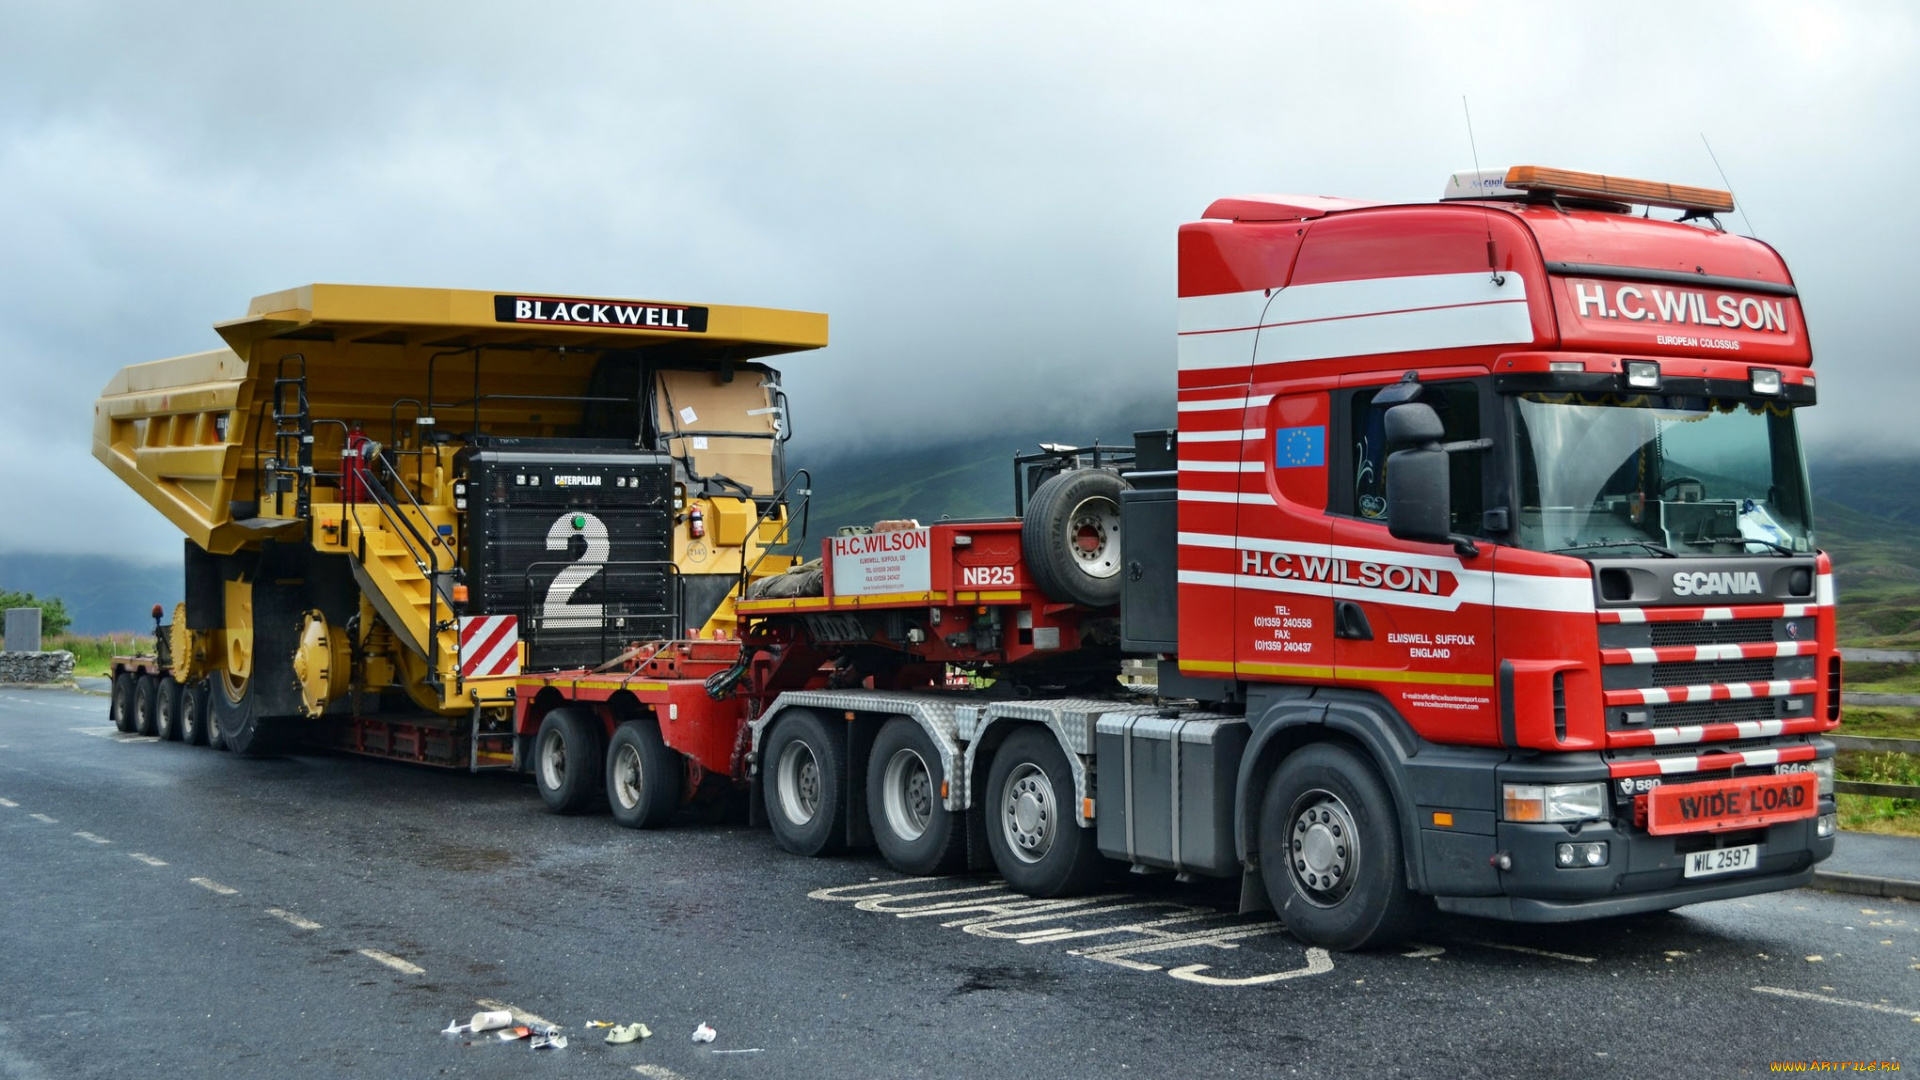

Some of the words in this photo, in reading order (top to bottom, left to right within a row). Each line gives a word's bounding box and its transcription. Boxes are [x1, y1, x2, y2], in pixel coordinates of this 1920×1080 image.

[515, 299, 690, 328] BLACKWELL
[1575, 283, 1786, 332] H.C.WILSON
[1656, 335, 1698, 347] EUROPEAN
[1699, 337, 1740, 350] COLOSSUS
[554, 474, 602, 487] CATERPILLAR
[835, 530, 927, 556] H.C.WILSON
[541, 511, 610, 629] 2
[963, 566, 1015, 586] NB25
[1241, 550, 1439, 595] H.C.WILSON
[1672, 571, 1762, 596] SCANIA
[1274, 605, 1291, 616] TEL:
[1254, 615, 1281, 628] (0)1359
[1282, 617, 1313, 629] 240558
[1274, 629, 1291, 640] FAX:
[1387, 632, 1433, 646] ELMSWELL,
[1435, 634, 1476, 646] SUFFOLK
[1254, 639, 1282, 652] (0)1359
[1283, 641, 1313, 653] 240437
[1409, 647, 1451, 659] ENGLAND
[1678, 792, 1741, 820] WIDE
[1751, 785, 1805, 811] LOAD
[1693, 851, 1713, 872] WIL
[1717, 848, 1750, 869] 2597
